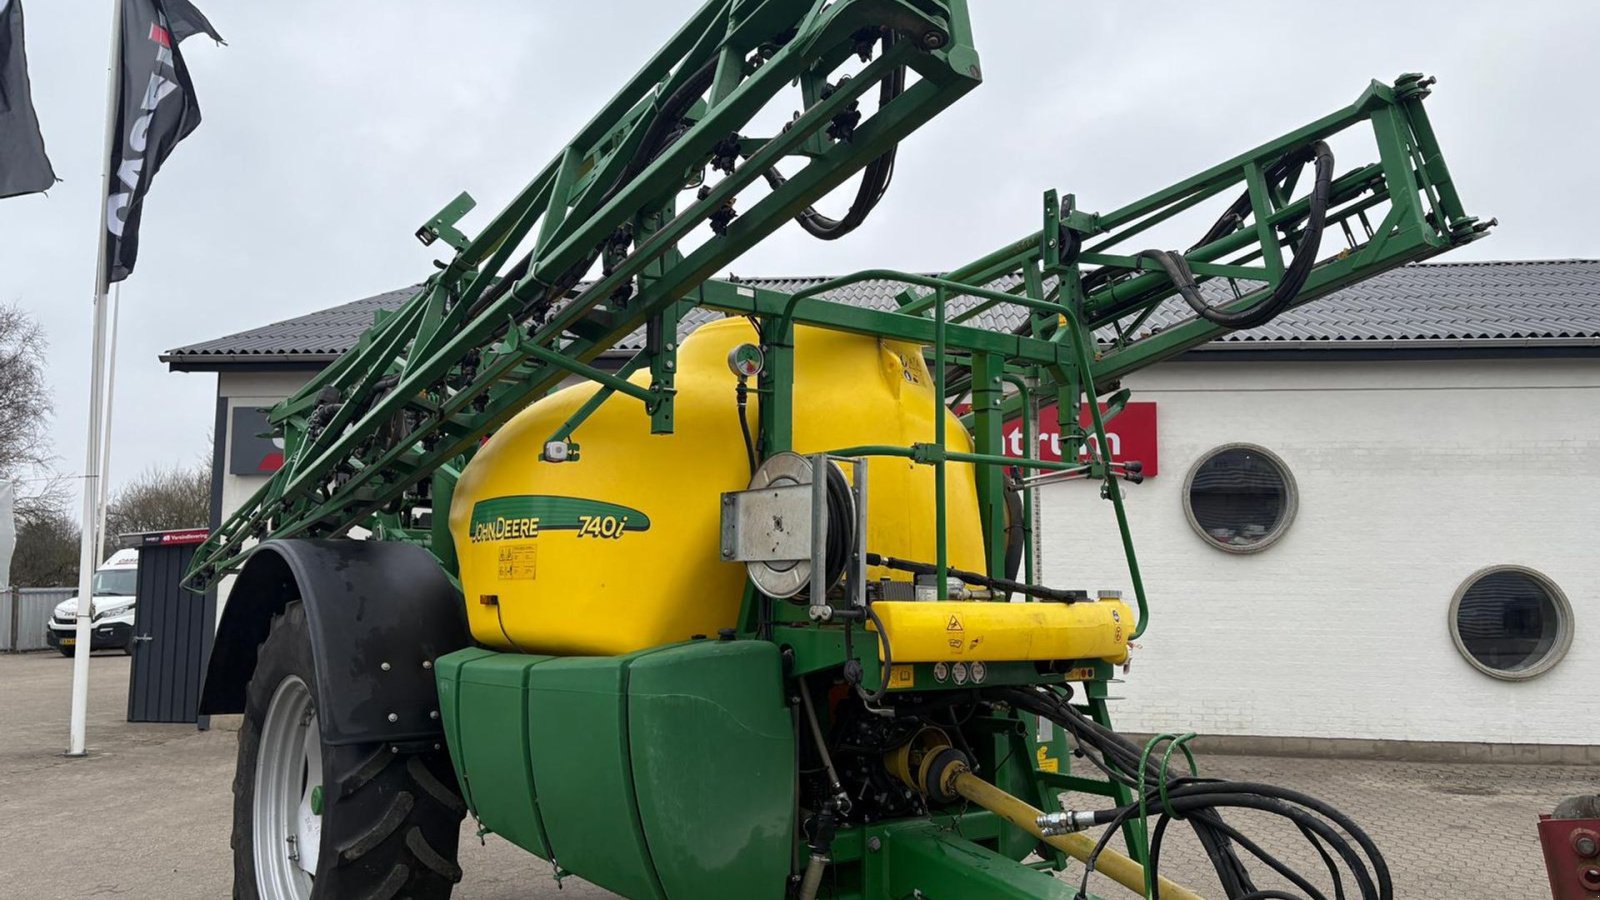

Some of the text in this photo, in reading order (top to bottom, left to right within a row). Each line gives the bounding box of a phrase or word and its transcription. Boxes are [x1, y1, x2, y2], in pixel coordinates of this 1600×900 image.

[472, 515, 628, 543] JOHN DEERE 740i
